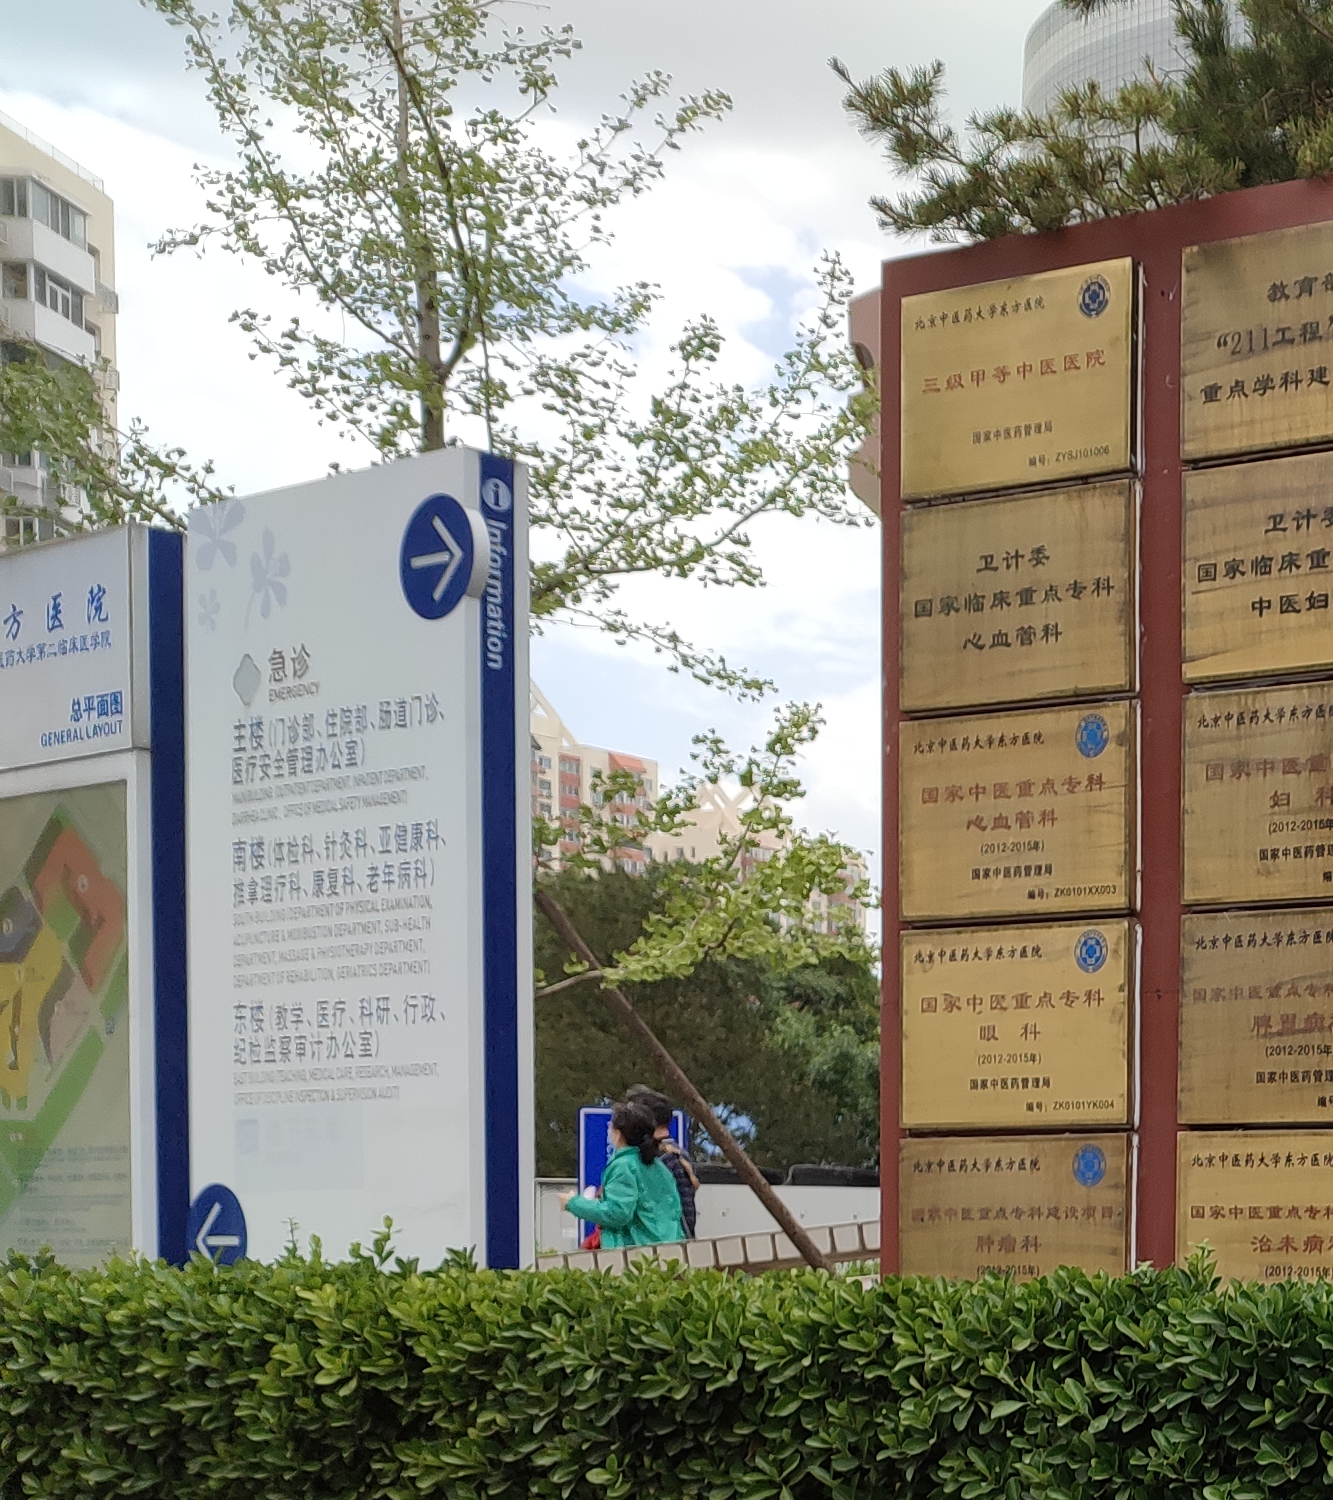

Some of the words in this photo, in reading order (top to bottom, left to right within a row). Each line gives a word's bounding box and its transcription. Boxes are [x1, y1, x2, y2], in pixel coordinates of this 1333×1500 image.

[914, 295, 1045, 330] 北京中医药大学东方医院
[922, 349, 1107, 394] 三级甲等中医医院
[972, 420, 1053, 444] 国家中医药管理局
[976, 544, 1050, 573] 卫计委
[486, 518, 508, 671] Information
[914, 576, 1115, 618] 国家临床重点专科
[963, 622, 1063, 651] 心血管科
[268, 643, 310, 683] 急诊
[268, 681, 320, 702] EMERGENCY
[70, 690, 123, 722] 总平面图
[40, 727, 83, 748] GENERAL
[86, 720, 123, 740] LAYOUT
[914, 731, 1045, 755] 北京中医药大学东方医院
[922, 772, 1107, 805] 国家中医重点专科
[966, 808, 1058, 832] 心血管科
[980, 840, 1045, 856] (2012-2015年)
[971, 863, 1053, 881] 国家中医药管理局
[913, 944, 1043, 964] 北京中医药大学东方医院
[921, 988, 1105, 1014] 国家中医重点专科
[980, 1022, 1041, 1042] 眼科
[977, 1053, 1042, 1066] (2012-2015年)
[969, 1076, 1051, 1091] 国家中医药管理局
[912, 1157, 1041, 1174] 北京中医药大学东方医院
[911, 1206, 1114, 1223] 国家中医重点专科建设项目
[976, 1234, 1042, 1254] 肿瘤科
